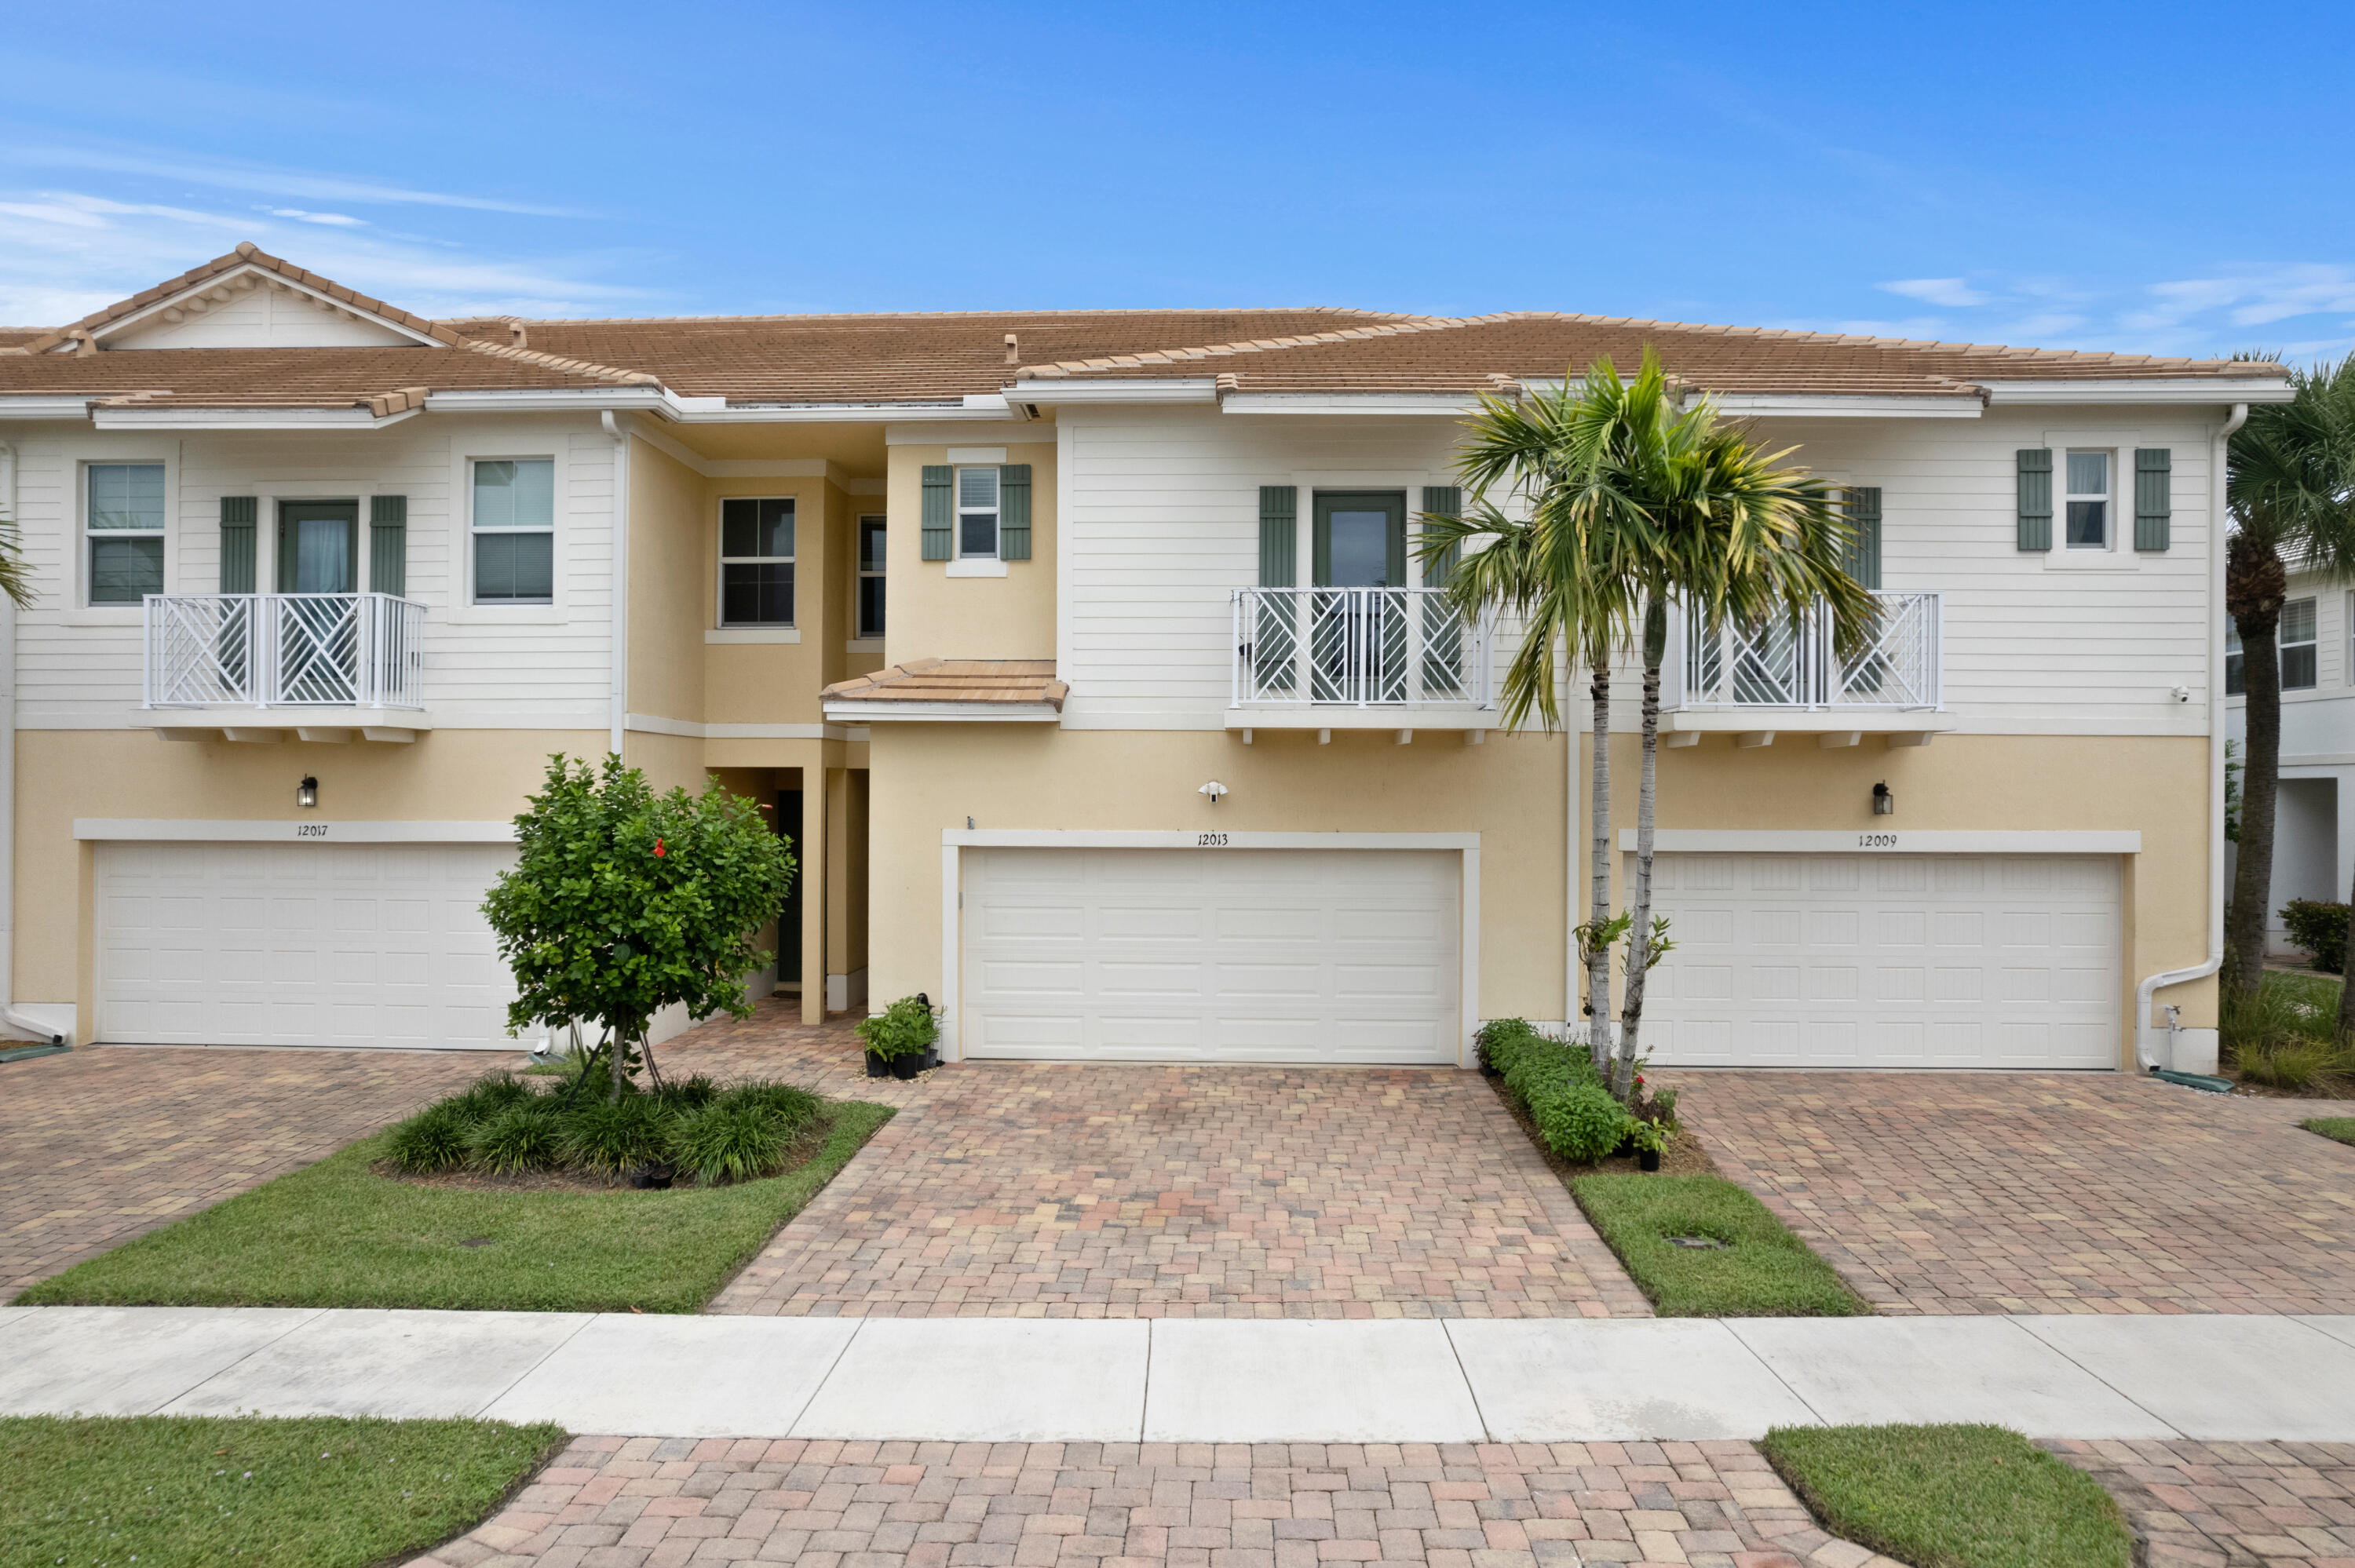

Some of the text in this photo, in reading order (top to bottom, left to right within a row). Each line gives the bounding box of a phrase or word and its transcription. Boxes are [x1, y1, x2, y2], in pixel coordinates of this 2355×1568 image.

[297, 825, 328, 837] 12017
[1198, 833, 1228, 846] 12013
[1859, 835, 1897, 848] 12009
